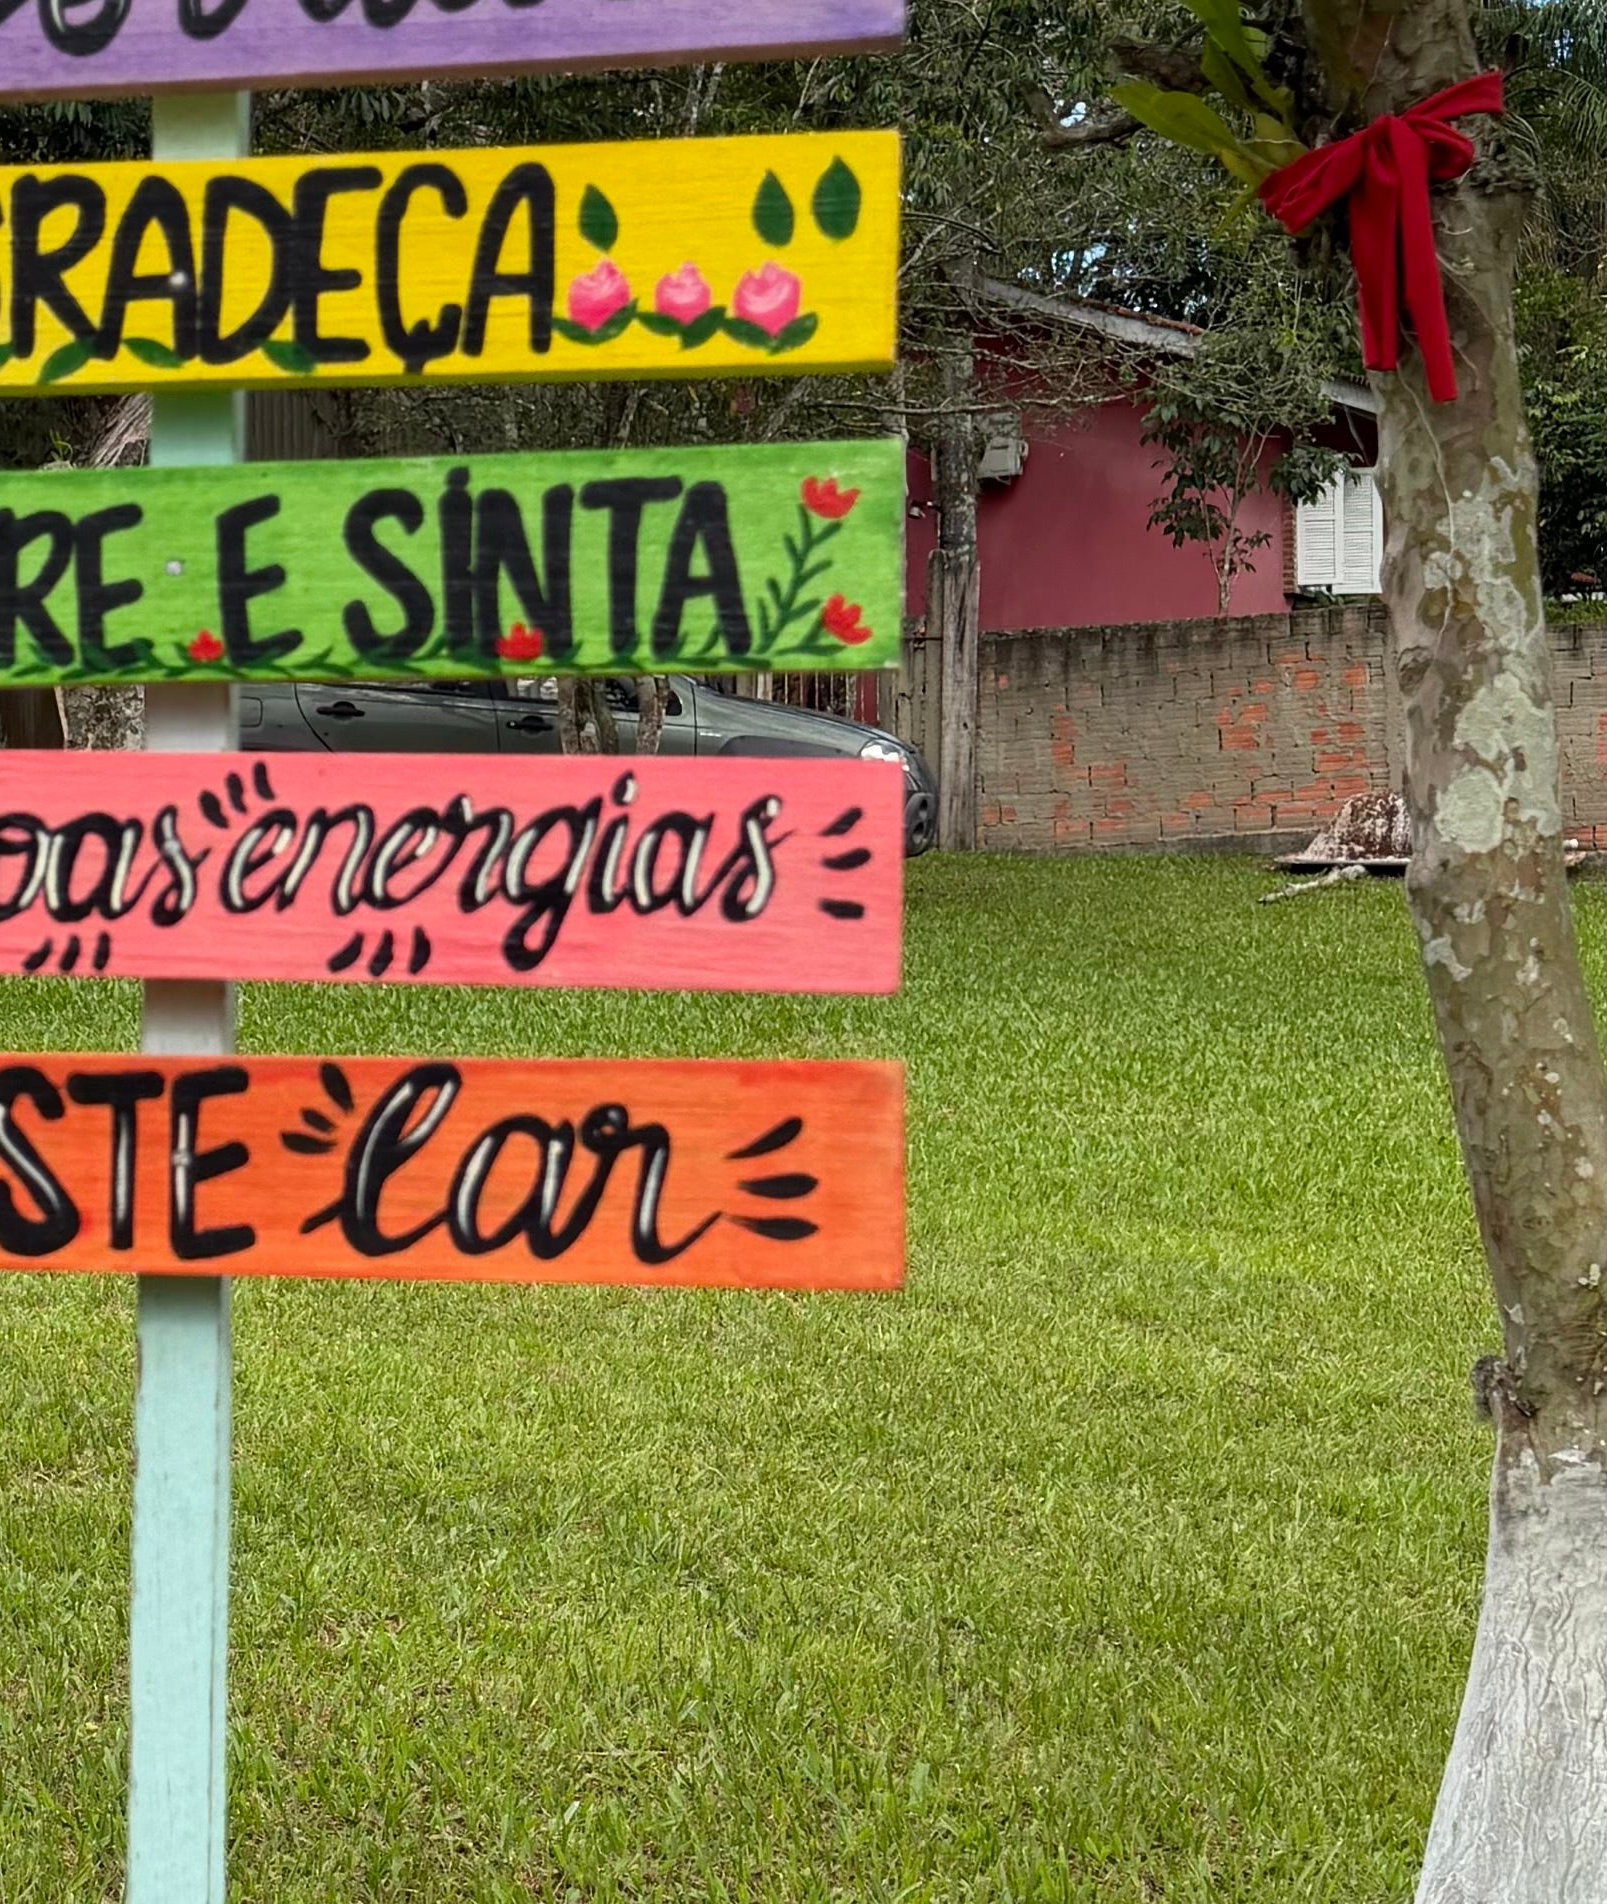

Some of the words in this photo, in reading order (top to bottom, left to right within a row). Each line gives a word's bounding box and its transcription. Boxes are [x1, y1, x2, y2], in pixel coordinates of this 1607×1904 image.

[216, 494, 304, 665] E
[217, 770, 796, 972] energias
[300, 1061, 726, 1266] lar
